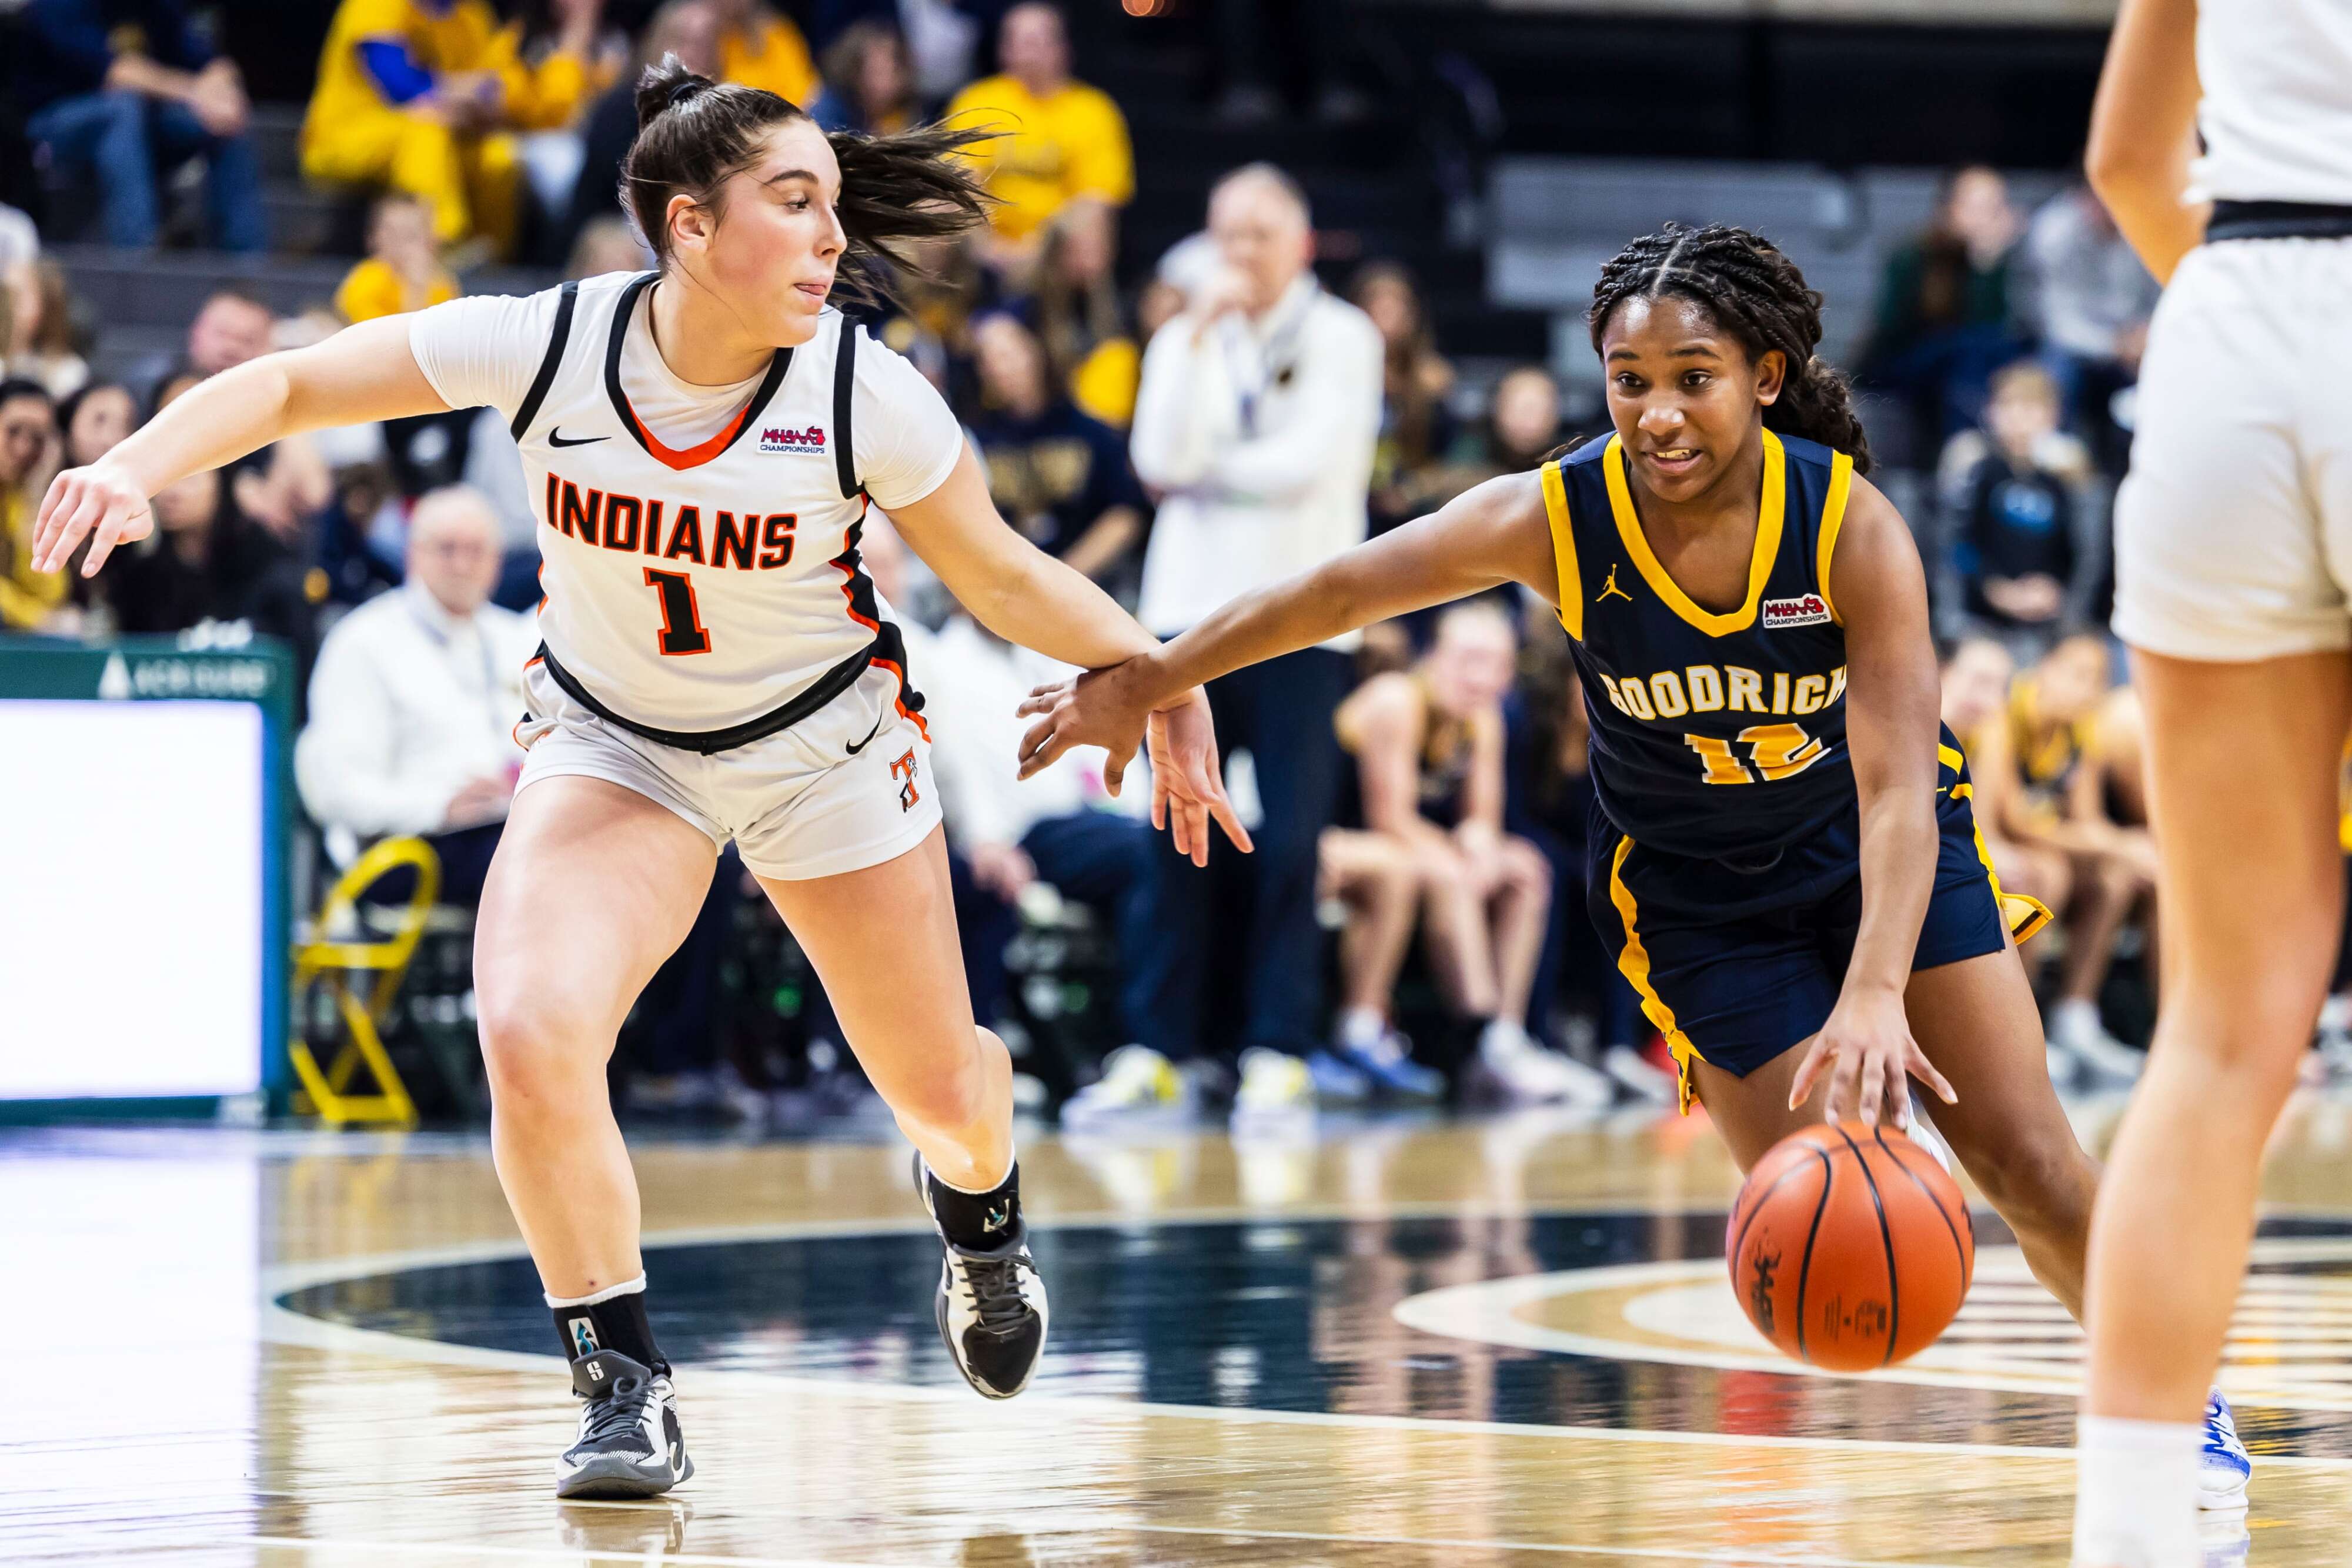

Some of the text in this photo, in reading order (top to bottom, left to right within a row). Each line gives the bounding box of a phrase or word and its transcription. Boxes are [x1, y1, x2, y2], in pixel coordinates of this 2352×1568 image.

[760, 444, 825, 453] CHAMPIONSHIPS
[546, 472, 797, 570] INDIANS
[643, 566, 712, 656] 1
[1766, 614, 1828, 626] CHAMPIONSHIPS
[1685, 723, 1832, 784] 12
